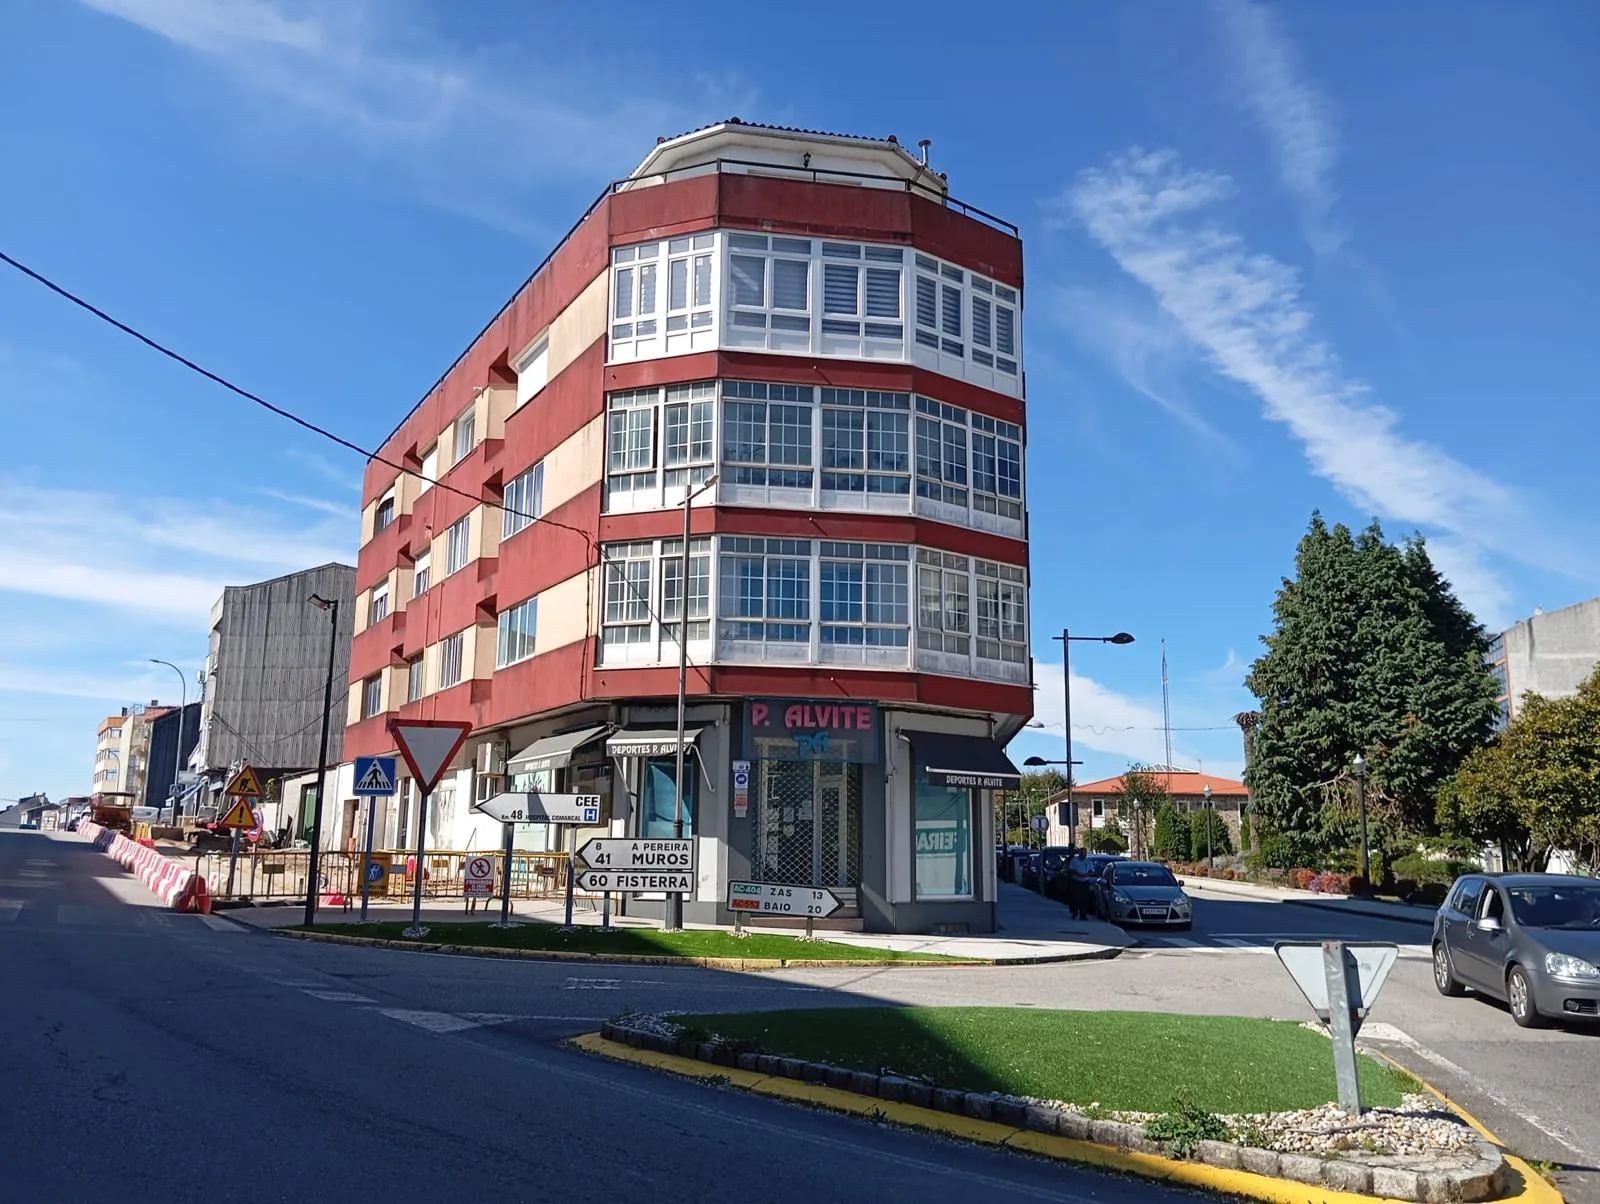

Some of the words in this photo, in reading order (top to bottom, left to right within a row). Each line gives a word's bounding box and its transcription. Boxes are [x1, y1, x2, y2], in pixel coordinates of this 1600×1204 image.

[751, 702, 771, 727] P.
[784, 704, 872, 730] ALVITE
[611, 745, 650, 754] DEPORTES
[652, 744, 659, 754] P.
[660, 743, 687, 754] ALVI
[946, 775, 976, 785] DEPORTES
[983, 777, 1003, 787] ALVITE
[575, 796, 599, 807] CEE
[510, 809, 523, 820] 48
[595, 843, 602, 851] 8
[632, 843, 639, 851] A
[643, 843, 689, 851] PEREIRA
[595, 853, 611, 865] 41
[632, 853, 689, 865] MUROS
[589, 875, 608, 887] 60
[616, 875, 689, 888] FISTERRA
[770, 887, 793, 897] ZAS
[812, 891, 823, 900] 13
[764, 901, 791, 911] BAIO
[807, 905, 822, 914] 20
